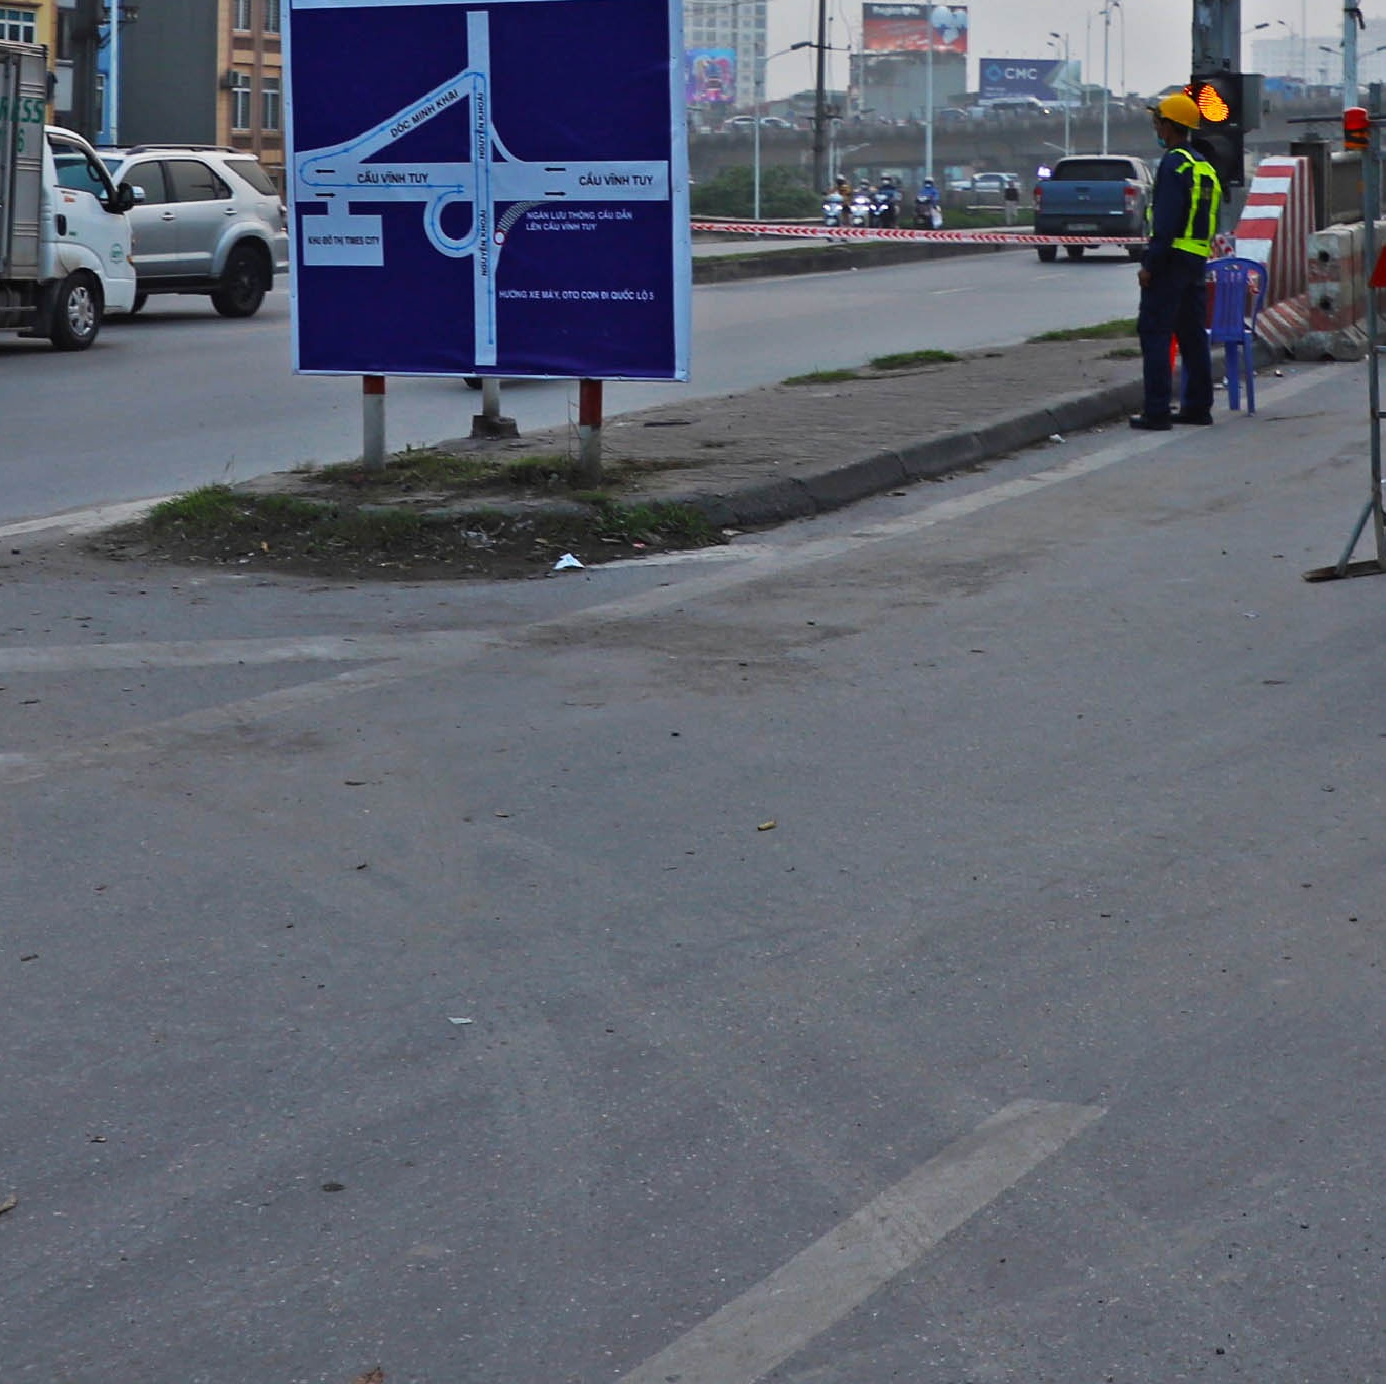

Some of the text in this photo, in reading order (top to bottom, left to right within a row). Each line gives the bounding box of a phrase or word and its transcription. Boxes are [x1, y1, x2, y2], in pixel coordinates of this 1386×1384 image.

[1004, 67, 1038, 80] CMC
[411, 104, 436, 125] MINH
[436, 88, 459, 108] KHAI
[409, 172, 429, 184] TUY
[632, 174, 654, 186] TUY
[528, 290, 541, 299] XE
[581, 291, 599, 300] CON
